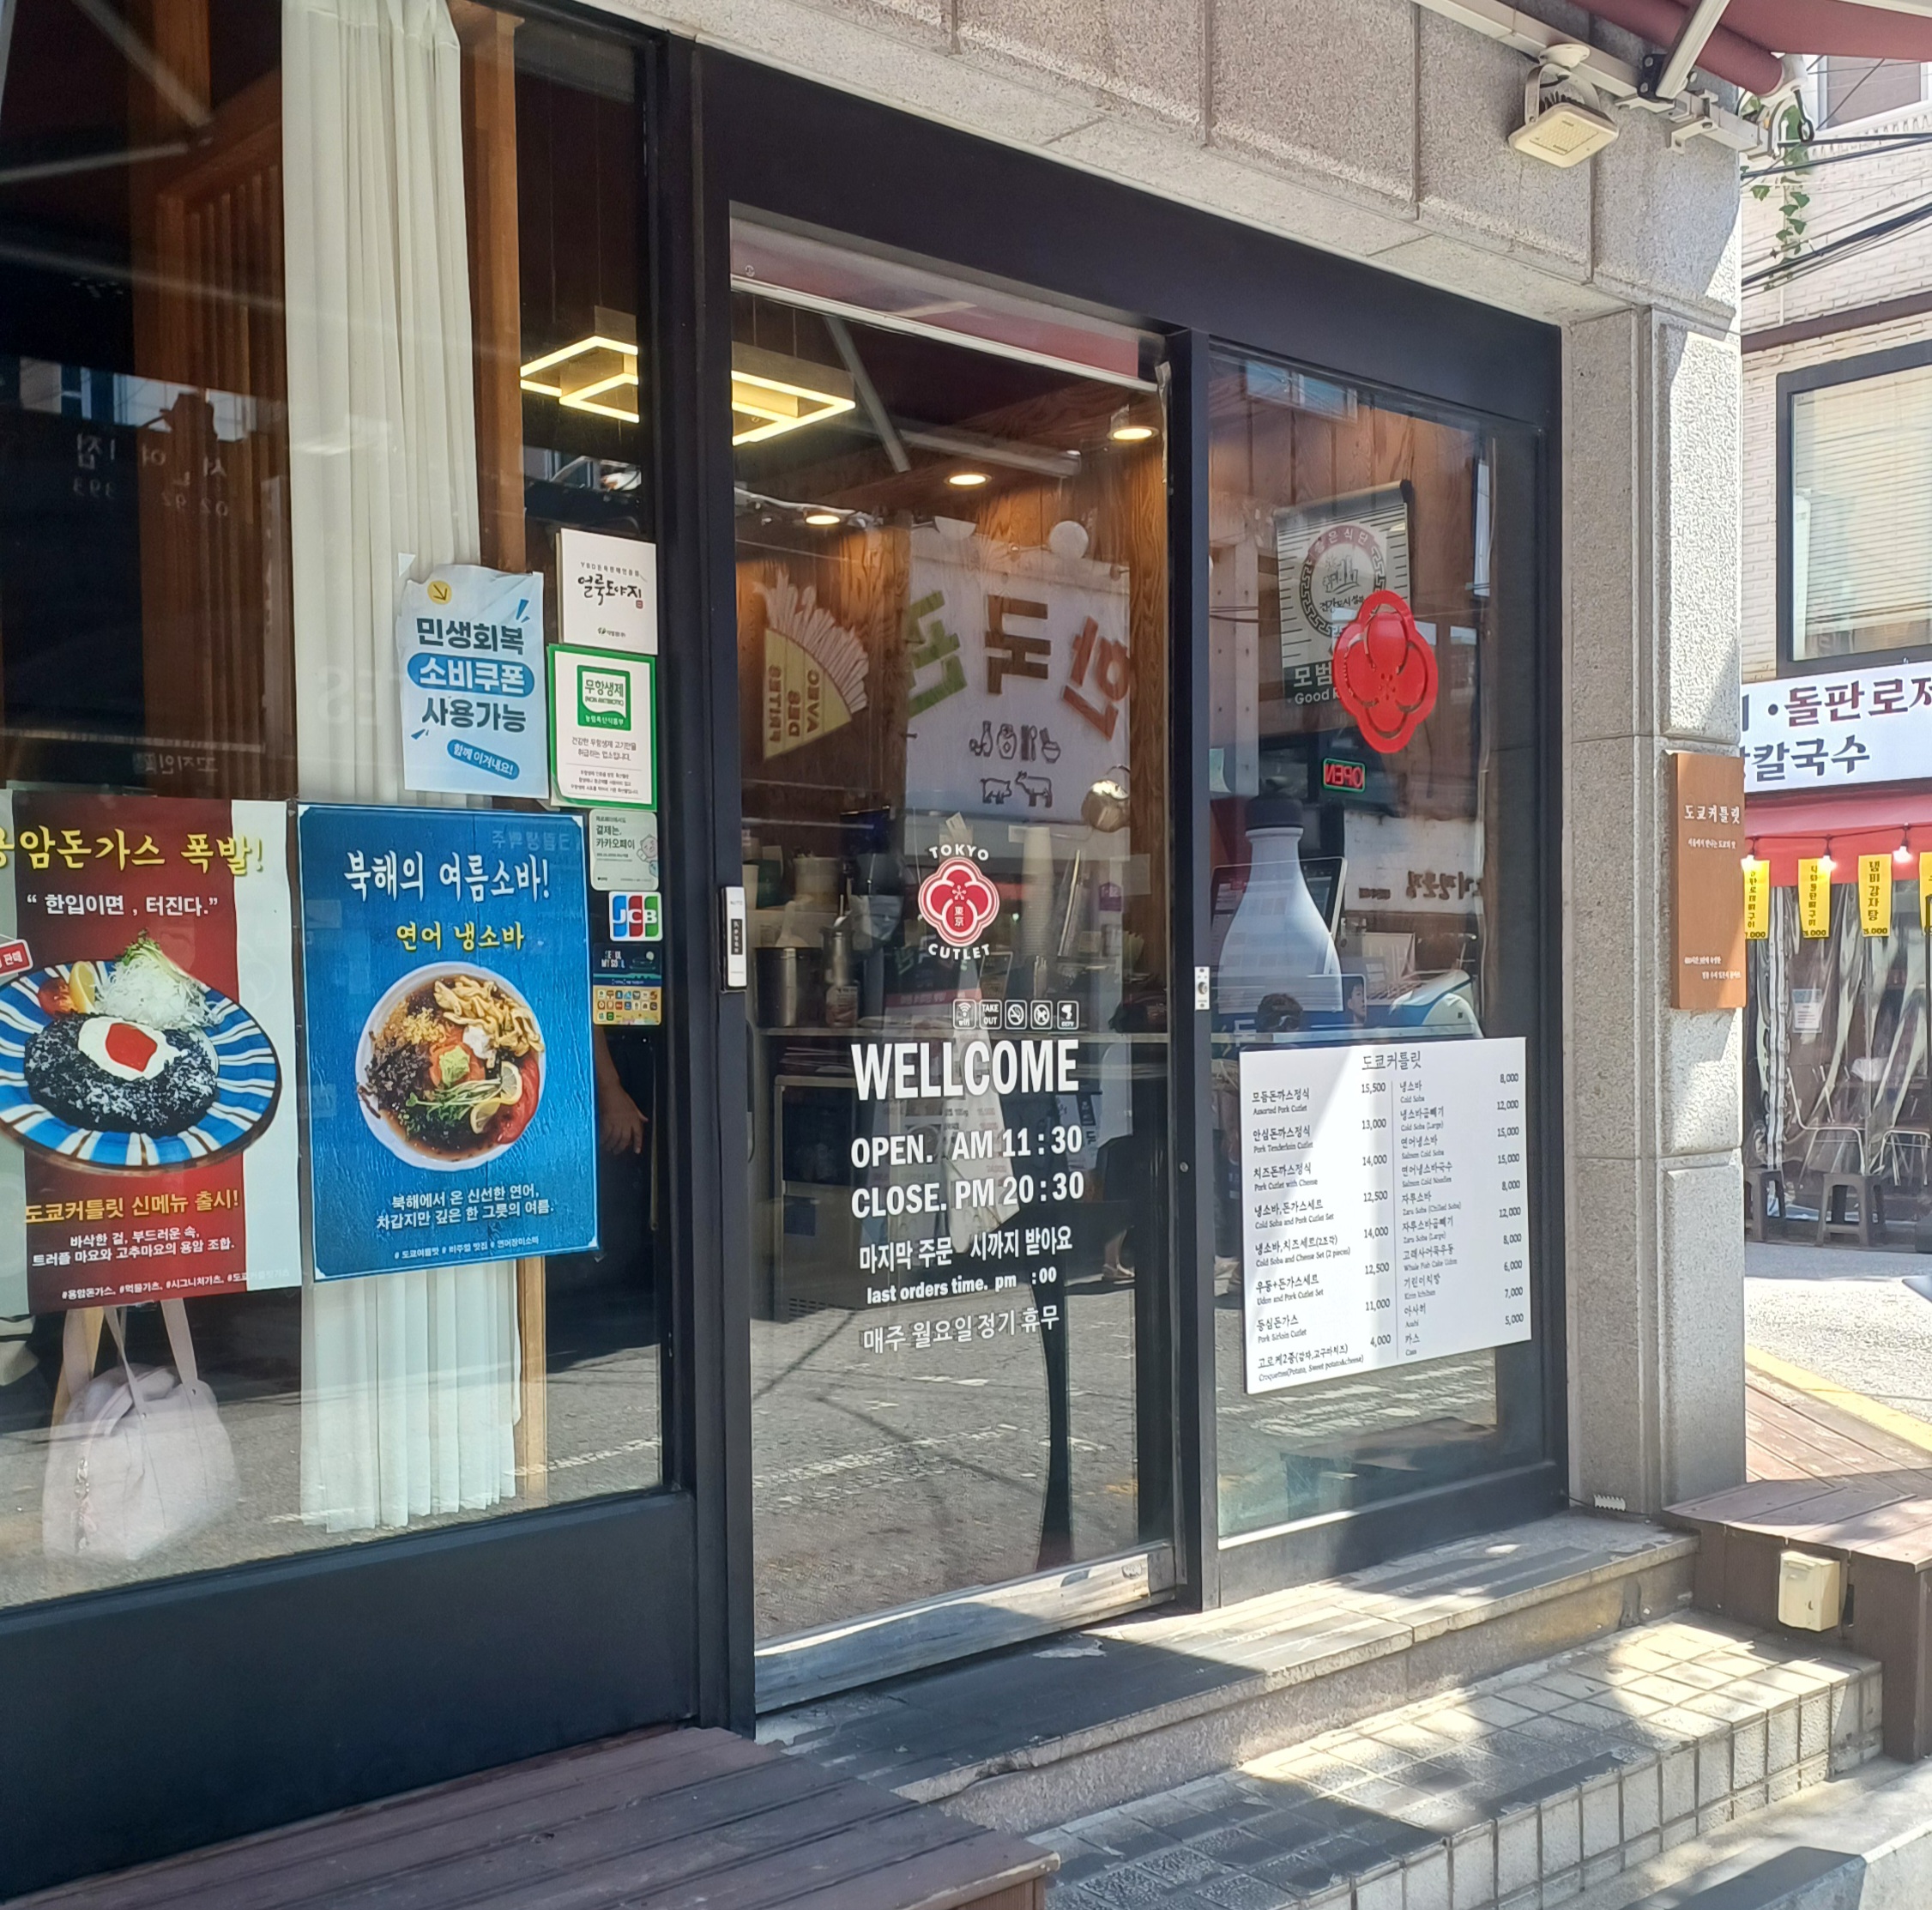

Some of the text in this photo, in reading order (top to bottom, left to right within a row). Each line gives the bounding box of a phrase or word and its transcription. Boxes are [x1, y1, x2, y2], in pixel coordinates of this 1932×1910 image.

[416, 617, 525, 656] 민생회복
[419, 657, 525, 694] 소비쿠폰
[1293, 660, 1333, 687] 모범
[584, 679, 625, 698] 무항생제
[1295, 688, 1330, 705] Good
[421, 697, 527, 733] 사용가능
[453, 741, 515, 776] 함께 이겨내요!
[595, 837, 635, 849] 카카오페이
[180, 832, 263, 876] 폭발!
[928, 843, 989, 861] TOKYO
[343, 848, 550, 904] 북해의 여름소바!
[1867, 861, 1881, 922] 냄비감자탕
[45, 894, 219, 917] 한입이면 터진다.”
[612, 908, 658, 925] JCB
[954, 906, 964, 928] 東京
[395, 921, 525, 952] 연어 냉소바
[928, 943, 990, 960] CUTLET
[981, 1004, 999, 1013] TAKE
[958, 1018, 970, 1027] wifi
[983, 1017, 998, 1025] OUT
[1361, 1050, 1422, 1071] 도쿄커틀릿
[850, 1039, 1079, 1101] WELLCOME
[1500, 1073, 1519, 1084] 8,000
[1361, 1082, 1386, 1095] 15,500
[1496, 1099, 1519, 1110] 12,000
[1361, 1118, 1387, 1131] 13,000
[1497, 1126, 1519, 1138] 15,000
[850, 1134, 933, 1169] OPEN.
[951, 1129, 993, 1161] AM
[1361, 1154, 1387, 1167] 14,000
[1497, 1152, 1520, 1164] 15,000
[1501, 1180, 1521, 1192] 8,000
[392, 1183, 540, 1211] 북해에서 온 신선한 연어,
[851, 1182, 947, 1219] CLOSE.
[955, 1177, 994, 1210] PM
[1363, 1190, 1388, 1203] 12,500
[24, 1188, 240, 1224] 도쿄커틀릿 신메뉴 출시!
[376, 1199, 554, 1230] 차갑지만 깊은 한 그릇의 여름.
[1499, 1206, 1522, 1218] 12,000
[70, 1234, 108, 1249] 바삭한
[131, 1227, 182, 1242] 부드러운
[184, 1225, 200, 1239] 속,
[1363, 1226, 1389, 1239] 14,000
[1503, 1233, 1523, 1245] 8,000
[32, 1236, 236, 1267] 트러플 마요와 고추마요의 용암 조합.
[859, 1225, 1073, 1274] 마지막 주문 시까지 받아요
[1364, 1262, 1390, 1275] 12,500
[1503, 1260, 1523, 1272] 6,000
[866, 1287, 897, 1305] last
[900, 1281, 949, 1301] orders
[951, 1275, 988, 1295] time.
[994, 1274, 1017, 1292] pm
[1504, 1286, 1524, 1299] 7,000
[1365, 1298, 1391, 1312] 11,000
[1505, 1313, 1524, 1326] 5,000
[863, 1304, 1060, 1354] 매주 월요일 정기 휴무
[1369, 1334, 1392, 1348] 4,000
[1404, 1333, 1421, 1345] 카스
